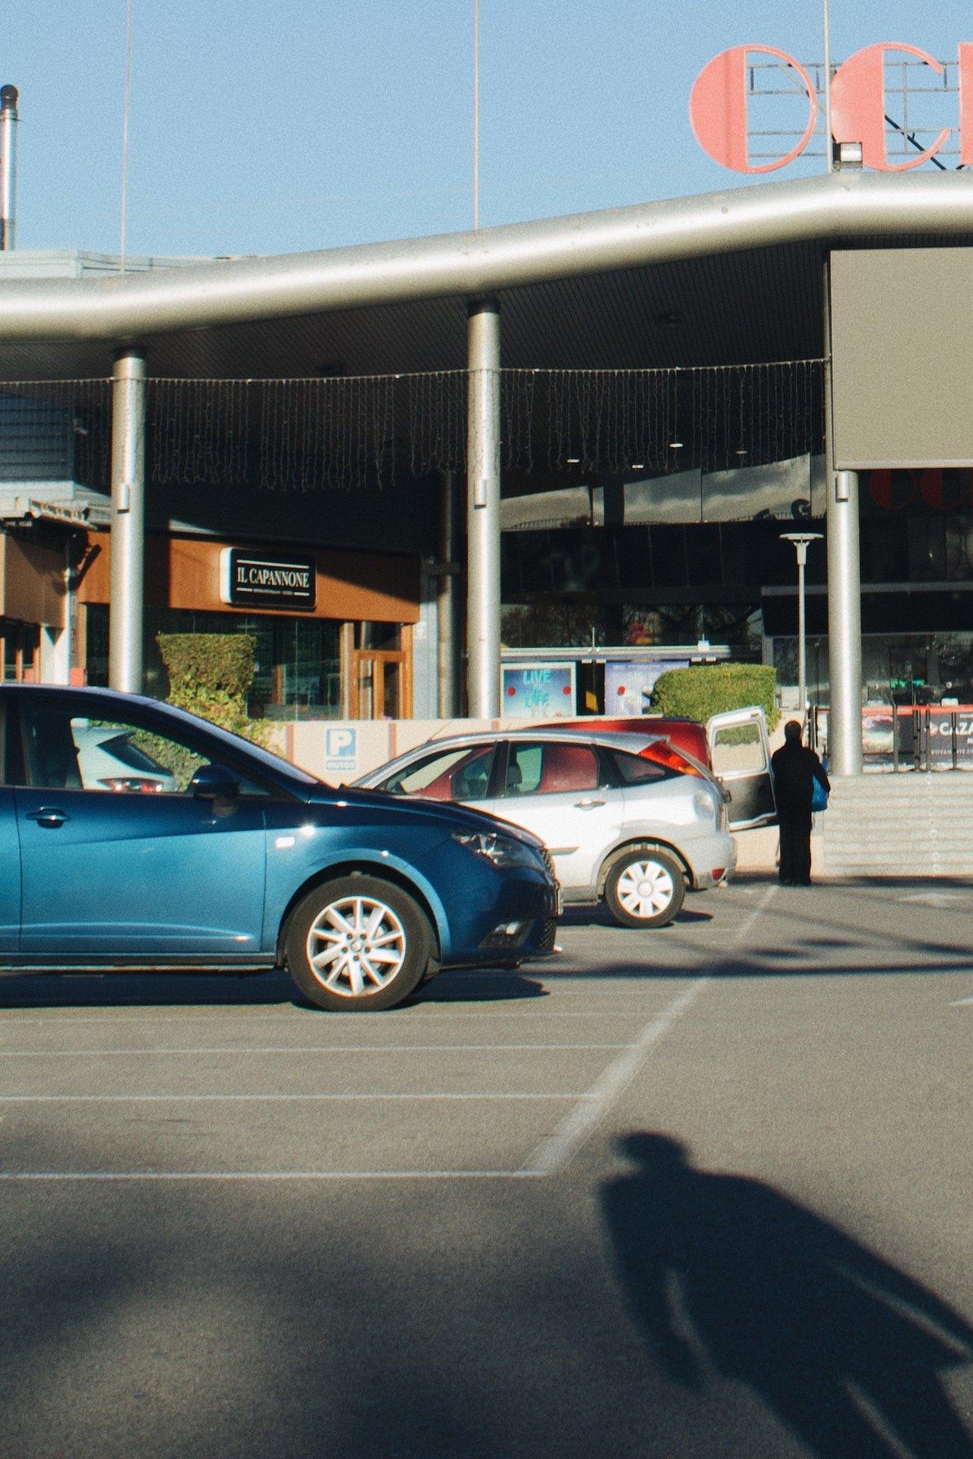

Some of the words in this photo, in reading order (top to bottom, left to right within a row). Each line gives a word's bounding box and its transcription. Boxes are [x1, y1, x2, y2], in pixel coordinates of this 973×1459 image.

[237, 567, 247, 583] IL
[249, 568, 309, 588] CAPANNONE
[523, 669, 552, 684] LIVE
[330, 730, 352, 756] P
